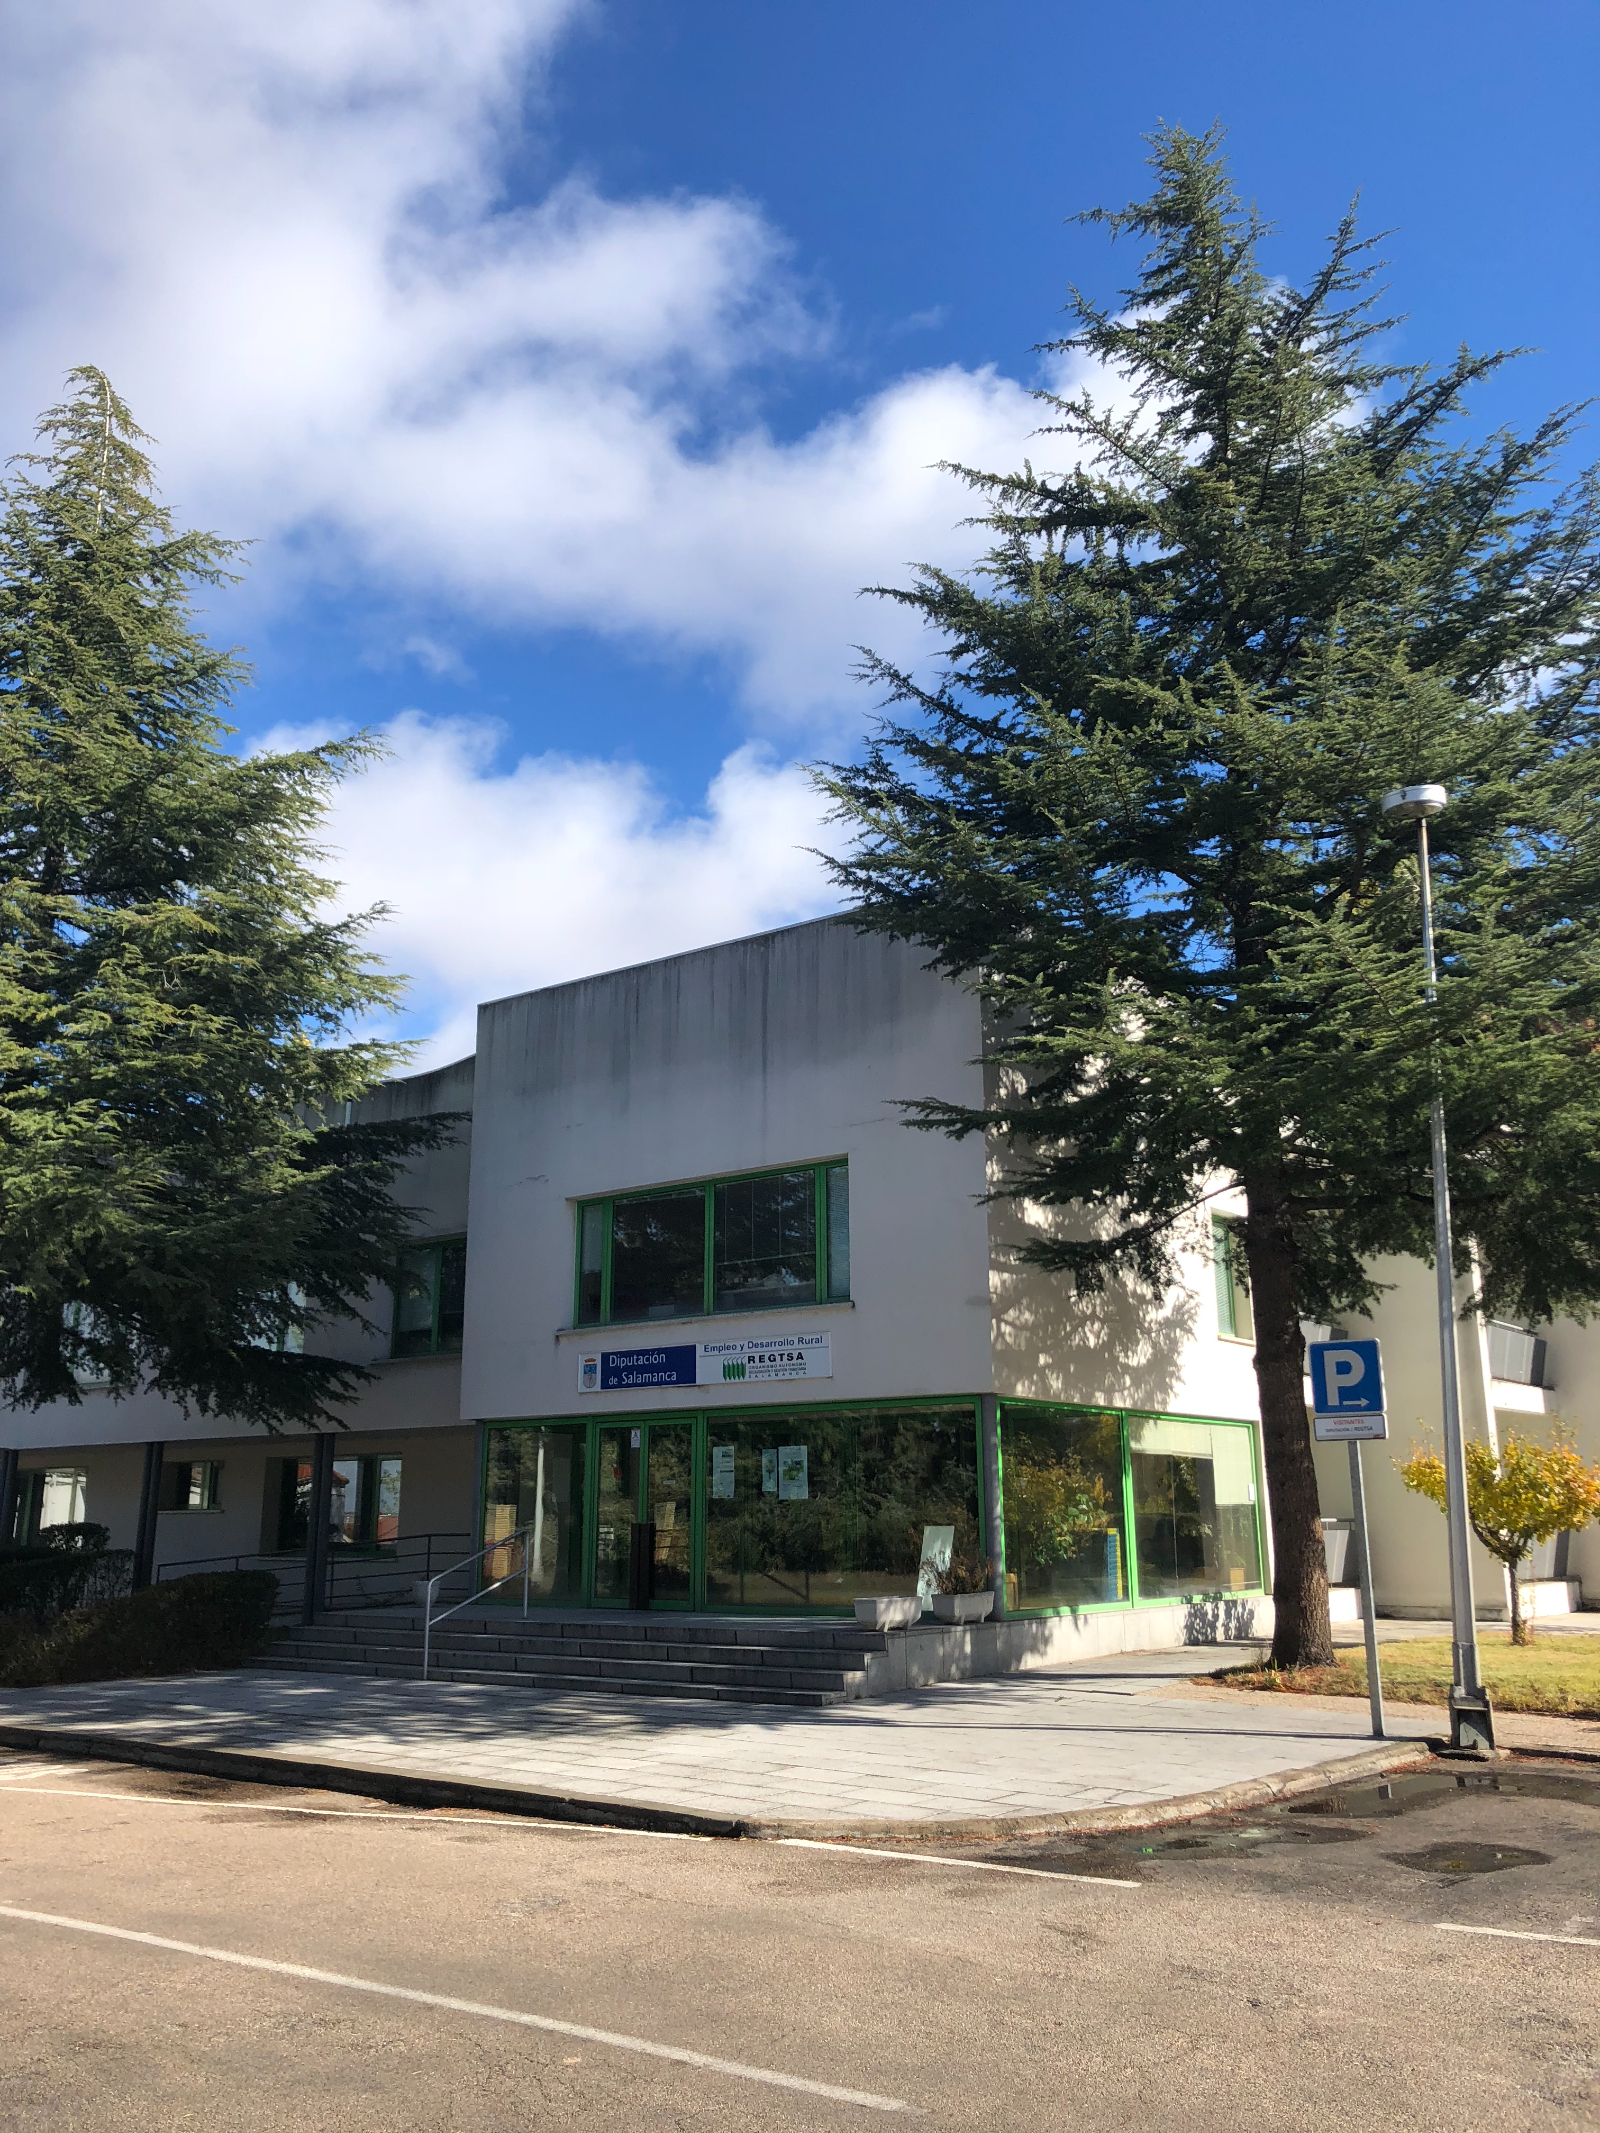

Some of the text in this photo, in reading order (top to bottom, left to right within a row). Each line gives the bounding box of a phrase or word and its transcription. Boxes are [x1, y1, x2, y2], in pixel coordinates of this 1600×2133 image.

[704, 1335, 823, 1353] Empleo y Desarrollo Rural
[609, 1351, 666, 1368] Diputación
[748, 1352, 804, 1363] REGTSA
[608, 1371, 677, 1385] de Salamanca
[1324, 1349, 1365, 1406] P
